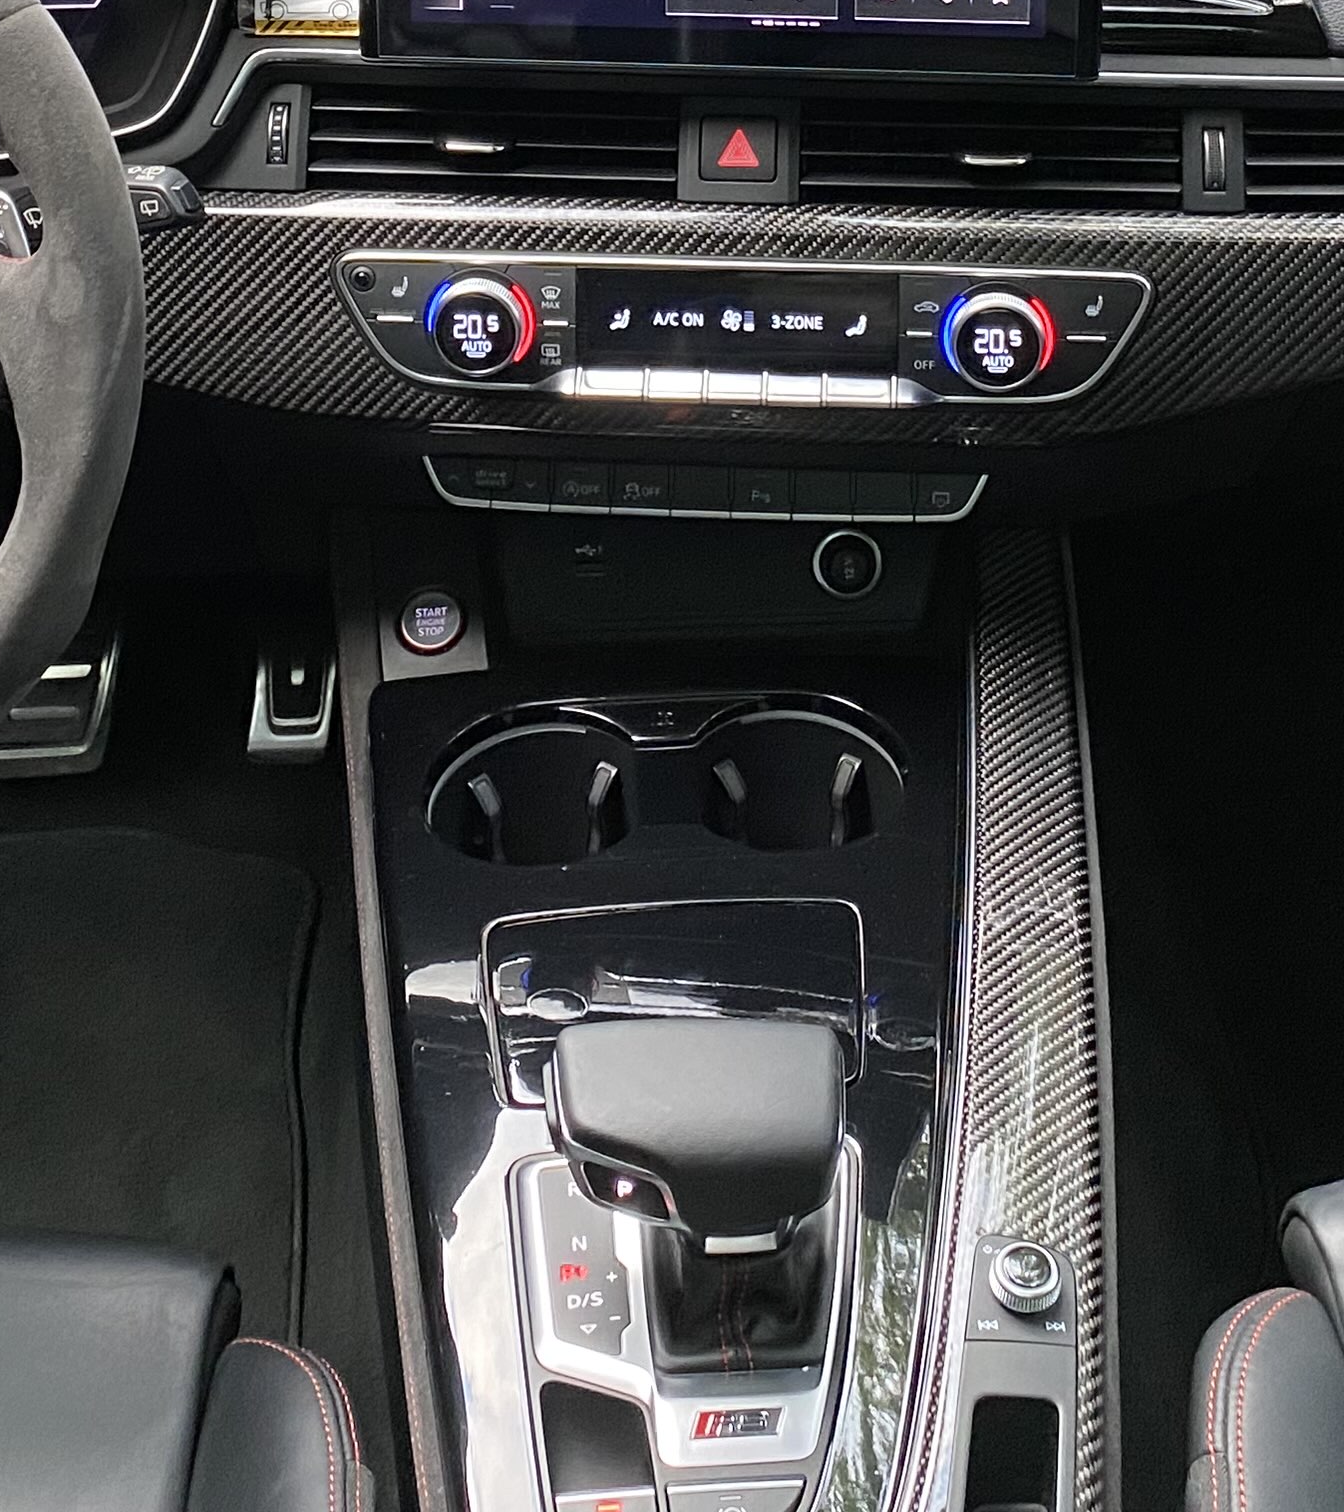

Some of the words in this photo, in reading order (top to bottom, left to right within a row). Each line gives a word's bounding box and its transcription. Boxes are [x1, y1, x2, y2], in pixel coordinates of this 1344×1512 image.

[653, 312, 679, 326] A/C
[682, 313, 704, 327] ON
[771, 315, 823, 330] 3-ZONE
[461, 340, 492, 352] AUTO
[914, 360, 935, 369] OFF
[982, 355, 1014, 367] AUTO
[415, 606, 447, 617] START
[416, 618, 446, 627] ENGINE
[418, 627, 444, 636] STOP
[616, 1179, 634, 1197] P
[571, 1236, 587, 1252] N
[567, 1291, 604, 1309] D/S
